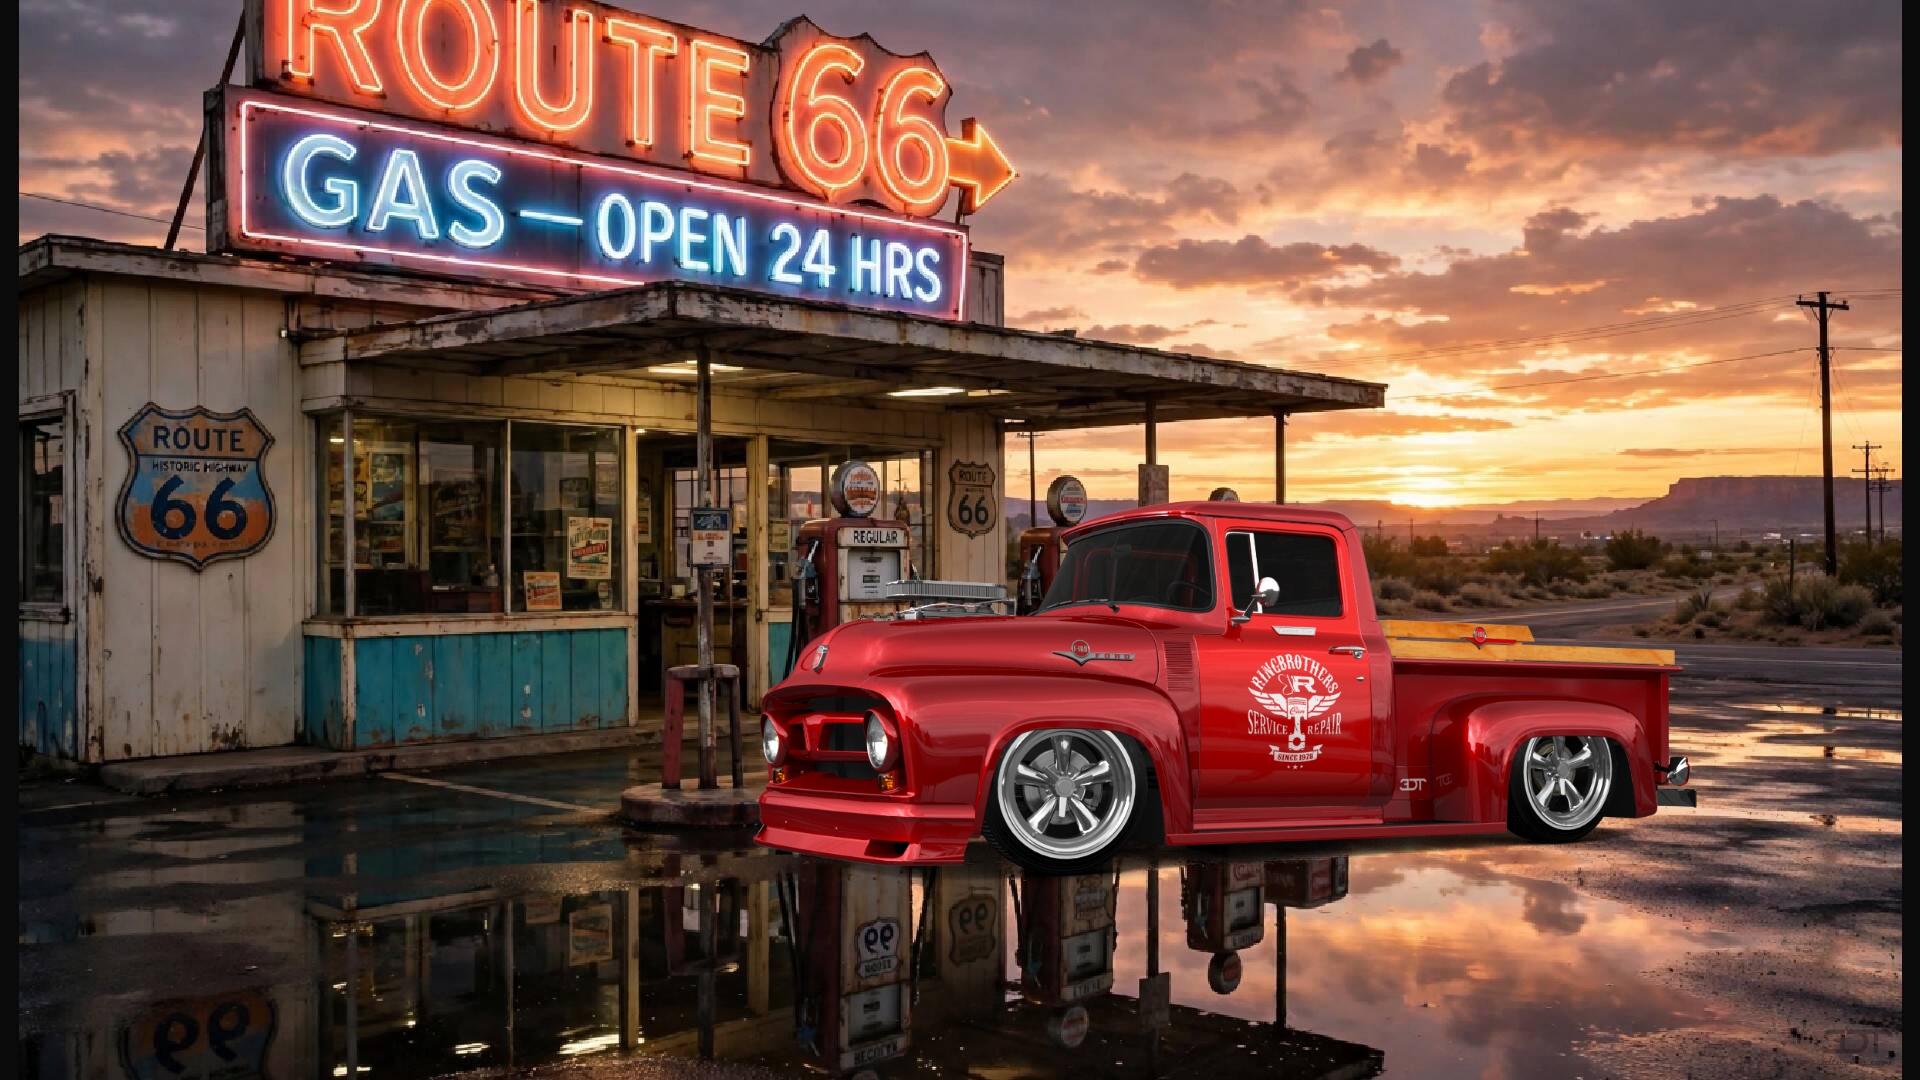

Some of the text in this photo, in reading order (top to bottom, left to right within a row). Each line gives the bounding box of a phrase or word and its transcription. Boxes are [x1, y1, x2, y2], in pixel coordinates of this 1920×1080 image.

[286, 0, 950, 204] ROUTE 66
[285, 134, 505, 248] GAS
[598, 193, 748, 277] OPEN
[773, 222, 836, 289] 24
[850, 234, 942, 303] HRS
[153, 425, 245, 452] ROUTE
[152, 460, 248, 473] HISTORIC HIGHWAY
[959, 469, 989, 483] ROUTE
[151, 474, 248, 540] 66
[958, 494, 989, 525] 66
[853, 530, 898, 544] REGULAR
[1250, 654, 1339, 694] RINGBROTHERS
[1247, 709, 1342, 735] SERVICE REPAIR
[1278, 753, 1314, 762] SINCE 1978
